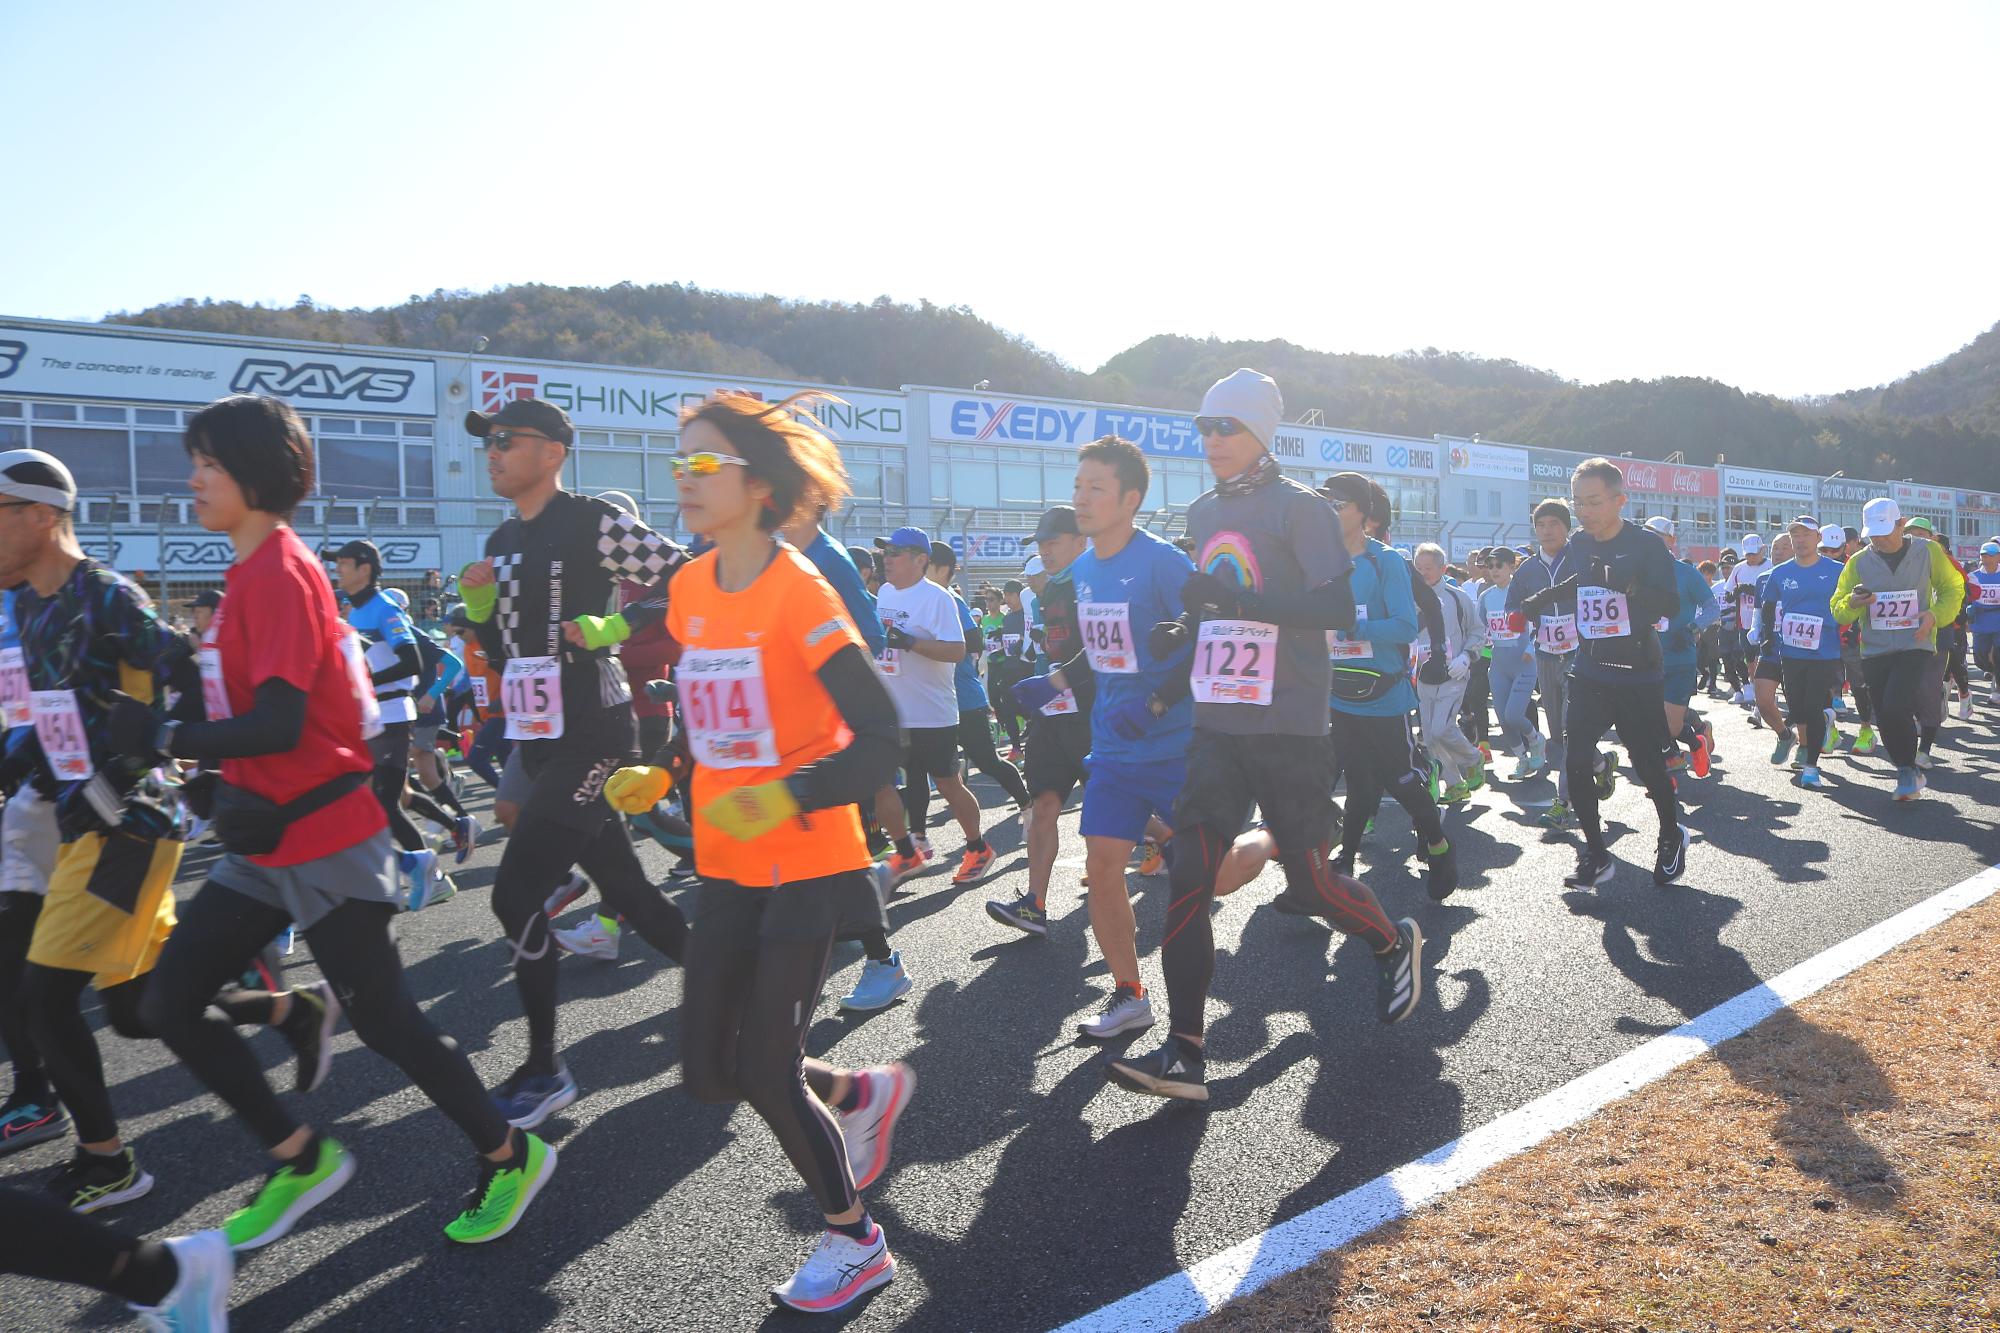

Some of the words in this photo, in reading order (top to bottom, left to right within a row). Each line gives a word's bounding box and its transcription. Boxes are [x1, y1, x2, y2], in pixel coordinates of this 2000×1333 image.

[41, 357, 72, 370] The
[76, 361, 145, 375] concept
[147, 365, 161, 376] is
[164, 368, 217, 380] racing.
[229, 358, 415, 402] RAYS
[951, 400, 1087, 443] EXEDY
[1344, 443, 1372, 464] ENKEI
[1408, 449, 1434, 469] ENKEI
[1533, 464, 1562, 477] RECARO
[1729, 475, 1755, 486] Ozone
[1759, 478, 1771, 488] Air
[1774, 480, 1811, 492] Generator
[1583, 598, 1619, 621] 356
[1877, 600, 1910, 617] 227
[1087, 621, 1123, 650] 484
[1545, 626, 1565, 642] 16
[1788, 621, 1815, 638] 144
[1205, 641, 1260, 676] 122
[689, 680, 751, 729] 614
